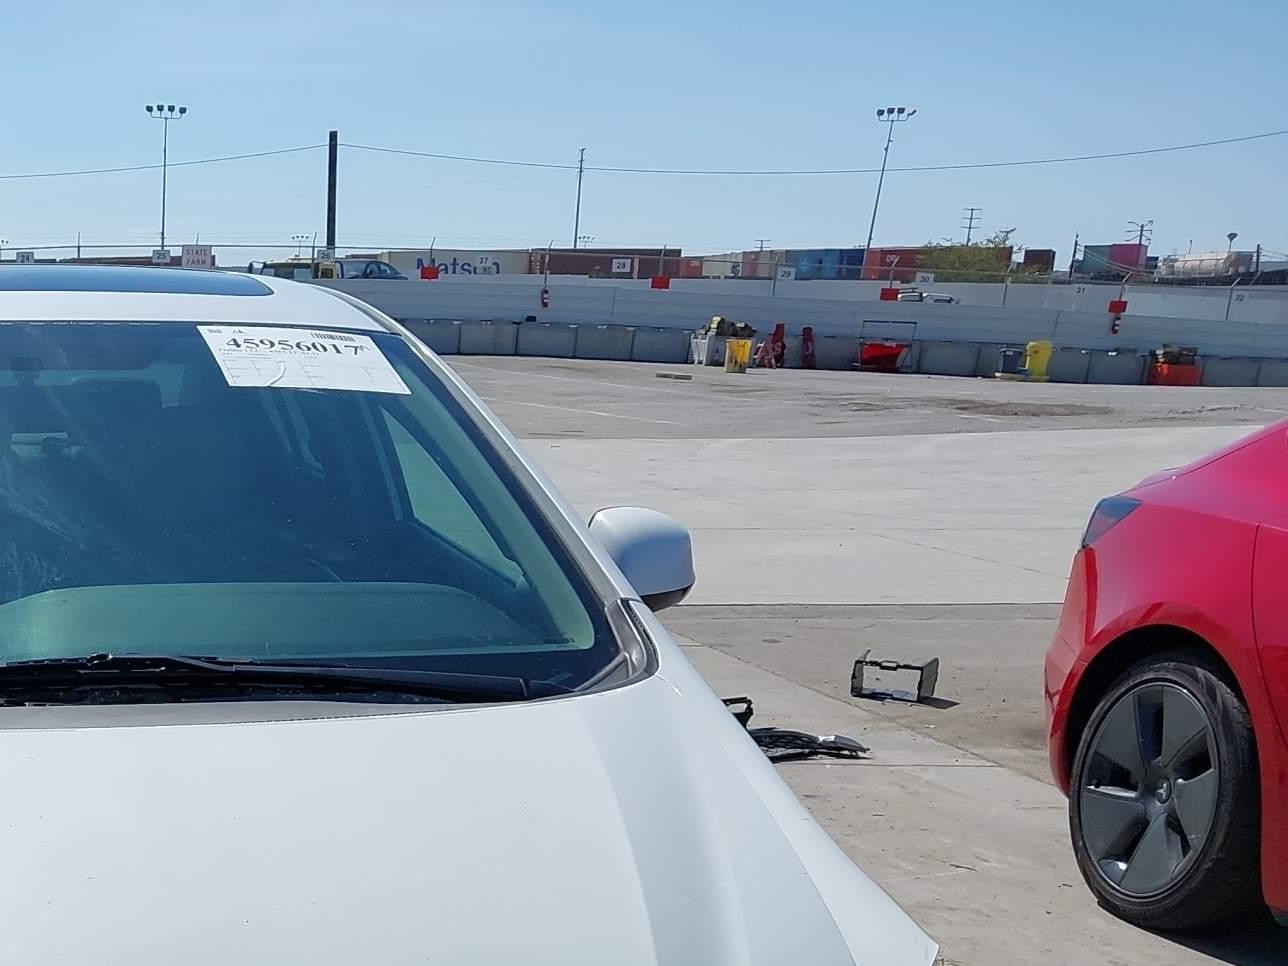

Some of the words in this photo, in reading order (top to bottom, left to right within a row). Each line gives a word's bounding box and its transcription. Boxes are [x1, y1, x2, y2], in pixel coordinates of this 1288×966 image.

[20, 255, 30, 263] 24
[156, 252, 167, 260] 25
[616, 261, 626, 269] 28
[780, 270, 791, 278] 29
[919, 275, 930, 283] 30
[226, 337, 359, 355] 45956017
